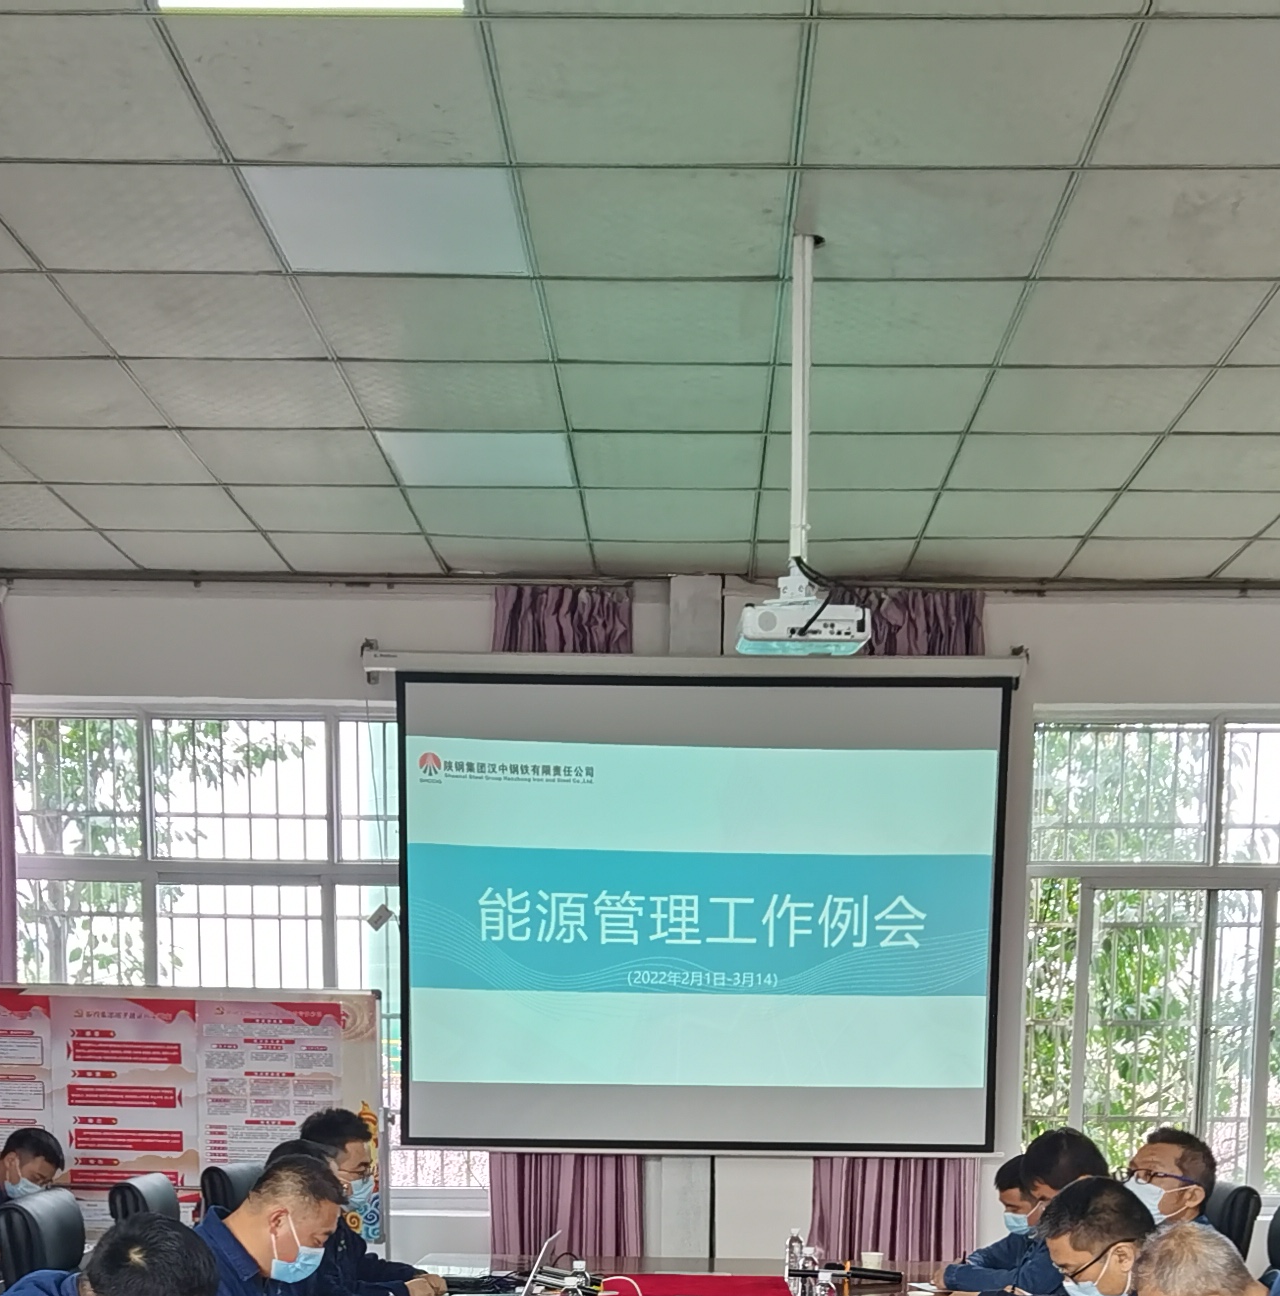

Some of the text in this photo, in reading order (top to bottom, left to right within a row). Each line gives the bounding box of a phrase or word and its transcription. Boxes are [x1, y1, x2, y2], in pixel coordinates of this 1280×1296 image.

[443, 759, 595, 778] 陕钢集团汉中钢铁有限责任公司
[477, 886, 928, 950] 能源管理工作例会
[627, 970, 778, 988] (2022年2月1日-3月14)
